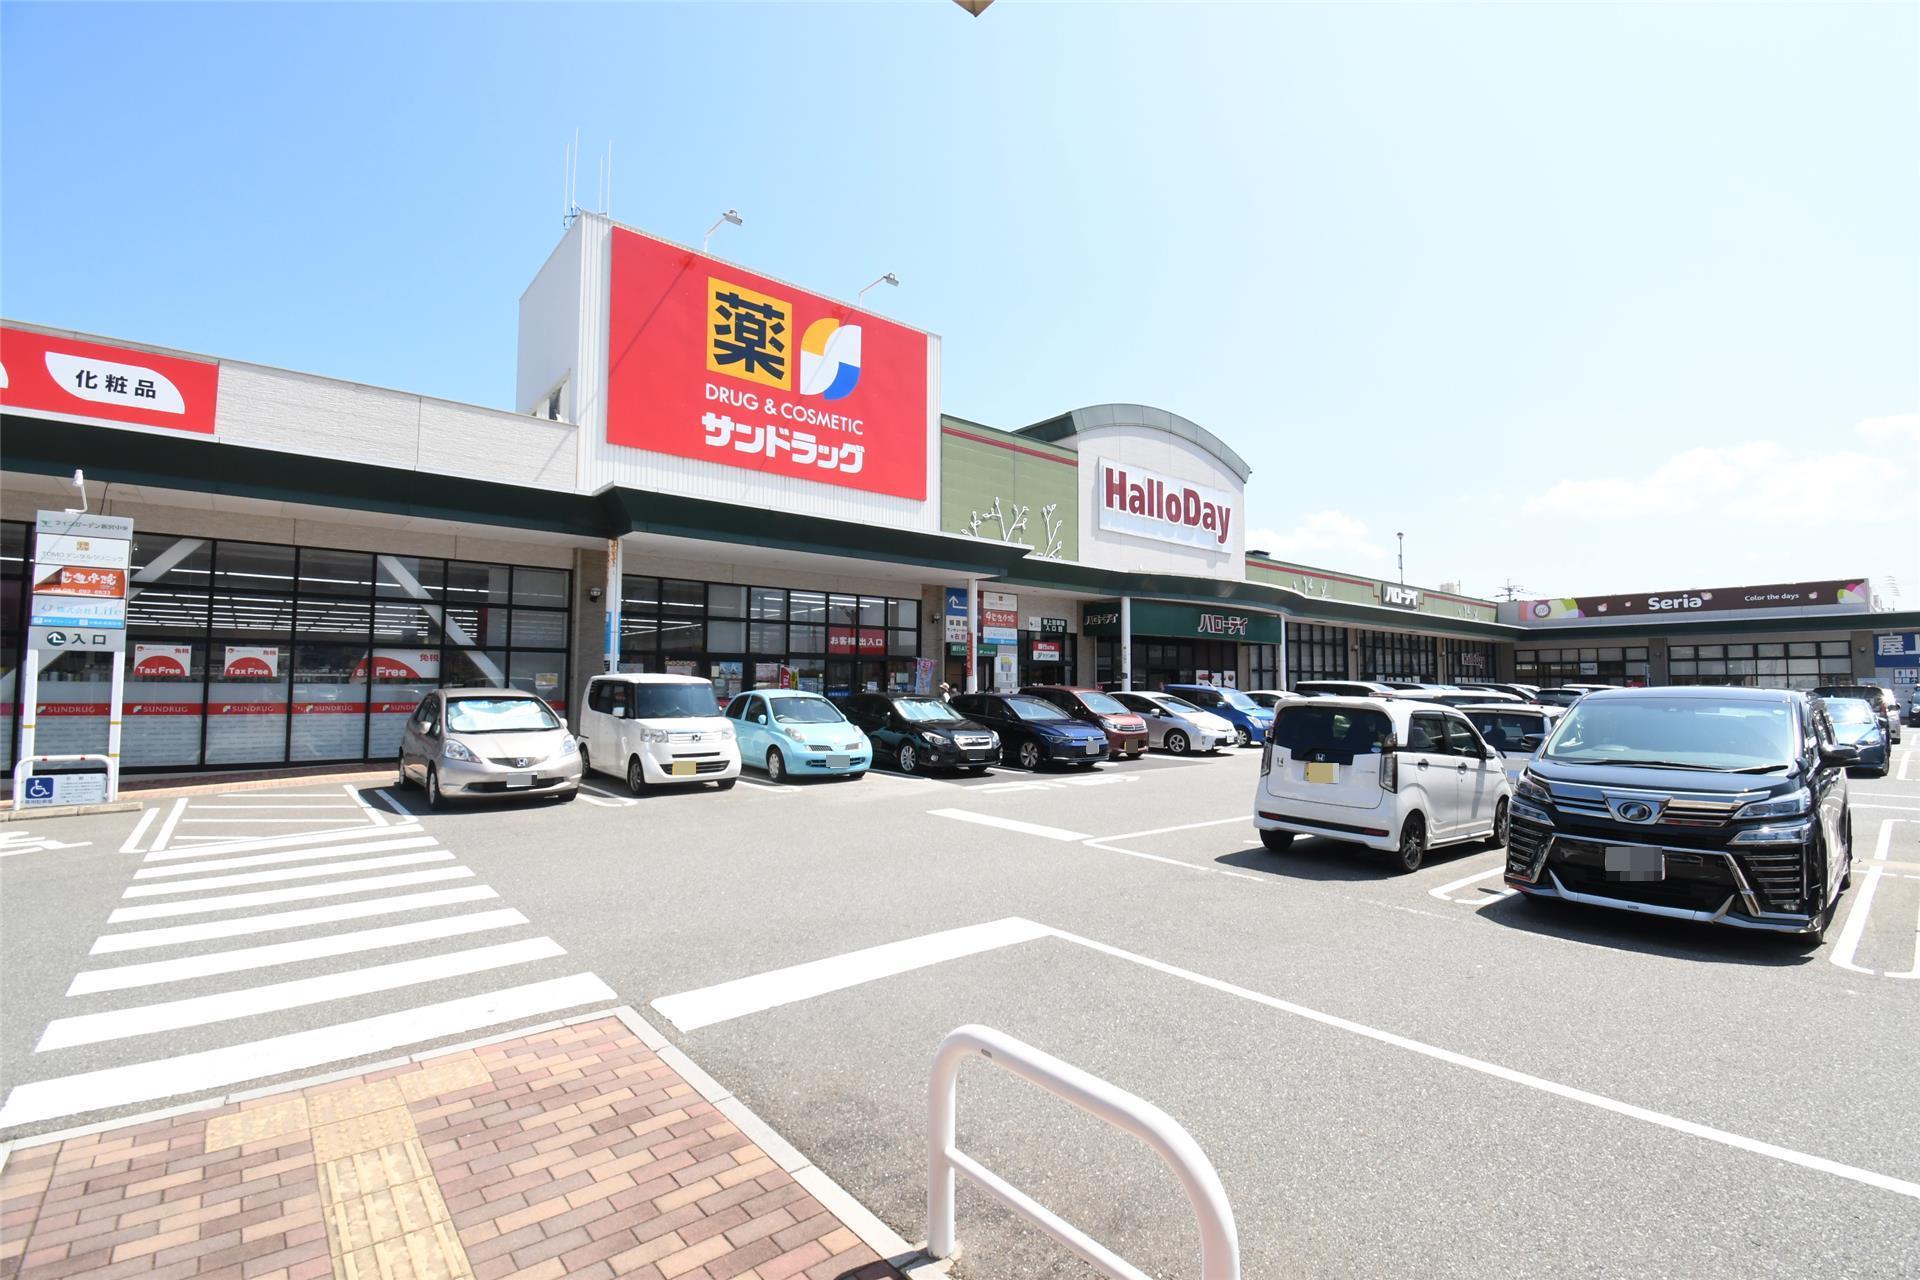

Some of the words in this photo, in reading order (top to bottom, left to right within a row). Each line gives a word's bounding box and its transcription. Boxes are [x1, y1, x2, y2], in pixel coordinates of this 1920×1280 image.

[713, 290, 785, 380] 薬
[75, 369, 157, 399] 化粧品
[705, 383, 759, 410] DRUG
[764, 398, 777, 415] &
[781, 402, 864, 435] COSMETIC
[701, 411, 865, 474] サンドラッグ
[1105, 467, 1231, 544] HalloDay
[1767, 593, 1780, 601] the
[1782, 592, 1799, 601] days
[1648, 594, 1703, 611] Seria
[71, 633, 106, 645] 入口
[138, 666, 157, 674] Tax
[158, 666, 181, 674] Free
[228, 667, 247, 675] Tax
[247, 667, 269, 675] Free
[375, 666, 407, 677] Free
[47, 705, 96, 713] SUNDRUG
[143, 705, 189, 713] SUNDRUG
[314, 704, 353, 712] SUNDRUG
